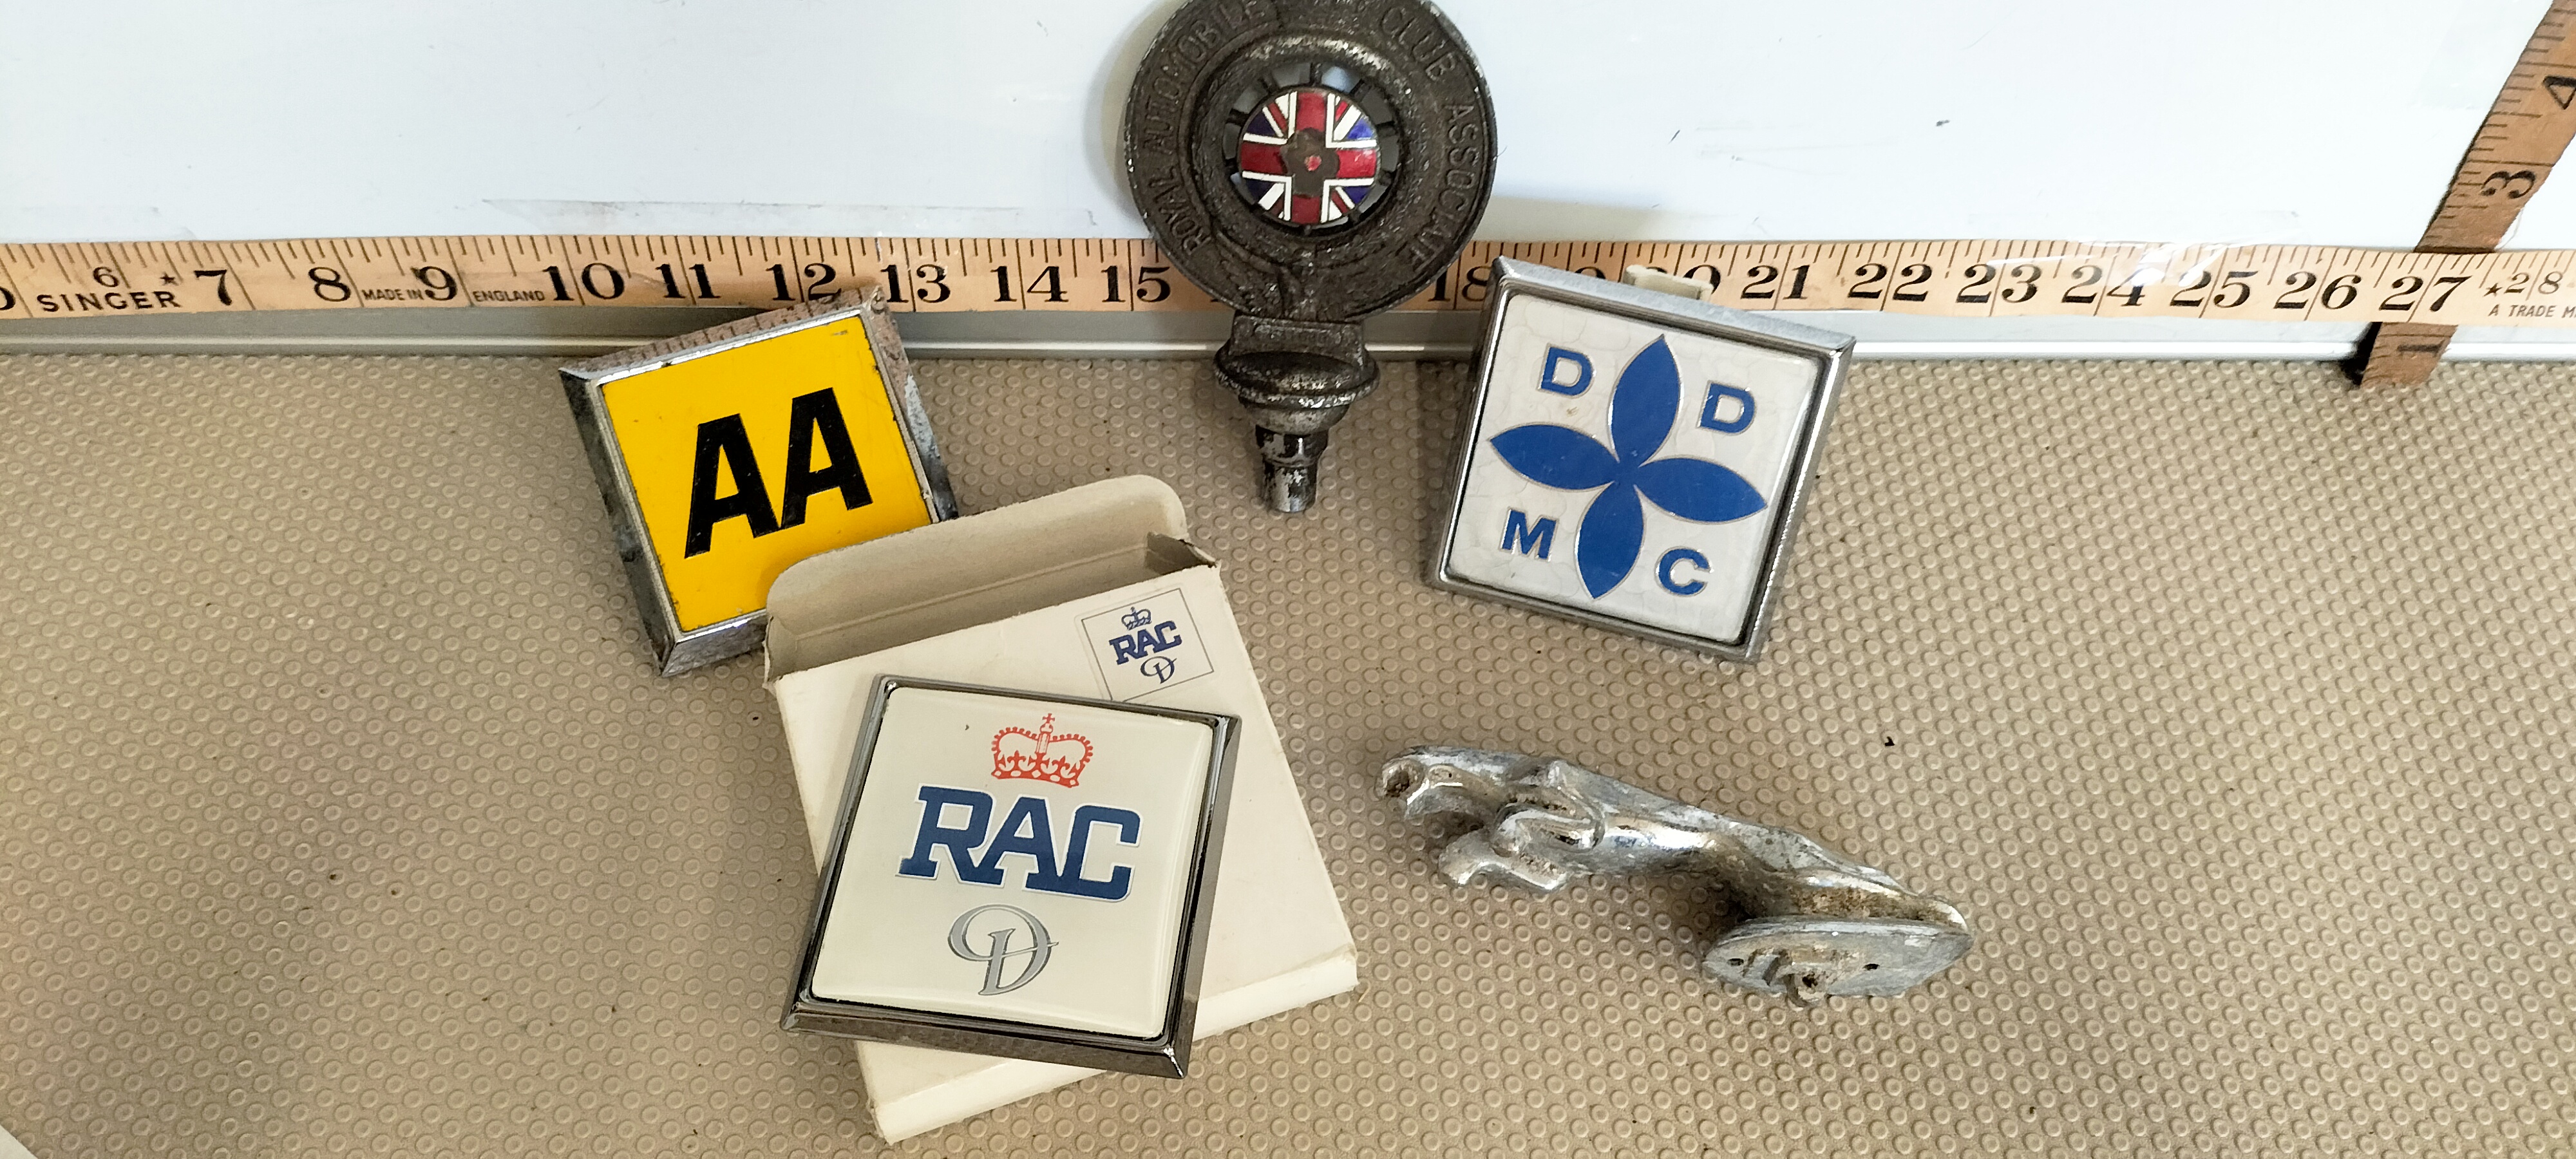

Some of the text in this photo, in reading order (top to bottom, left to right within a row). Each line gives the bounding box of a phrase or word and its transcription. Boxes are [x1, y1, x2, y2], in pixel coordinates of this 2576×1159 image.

[1148, 165, 1212, 255] ROYAL
[1380, 8, 1456, 81] CLUB
[2481, 171, 2536, 199] 3
[37, 290, 181, 312] SINGER
[93, 266, 119, 288] 6
[195, 269, 232, 306] 7
[308, 266, 351, 302] 8
[415, 266, 457, 301] 9
[543, 263, 625, 301] 10
[656, 263, 721, 299] 11
[766, 263, 841, 301] 12
[881, 264, 951, 304] 13
[990, 265, 1069, 302] 14
[1101, 265, 1171, 303] 15
[1428, 266, 1486, 302] 18
[1741, 264, 1810, 300] 21
[1848, 263, 1933, 302] 22
[1956, 263, 2042, 304] 23
[2061, 265, 2145, 307] 24
[2170, 270, 2259, 308] 25
[2273, 271, 2362, 310] 26
[2379, 276, 2472, 312] 27
[2503, 272, 2563, 294] 28
[362, 288, 545, 302] MADE IN ENGLAND
[2488, 304, 2576, 319] A TRADE M
[1539, 343, 1757, 435] D D
[684, 386, 873, 559] AA
[1501, 507, 1714, 597] M C
[1109, 620, 1182, 665] RAC
[895, 783, 1142, 902] RAC
